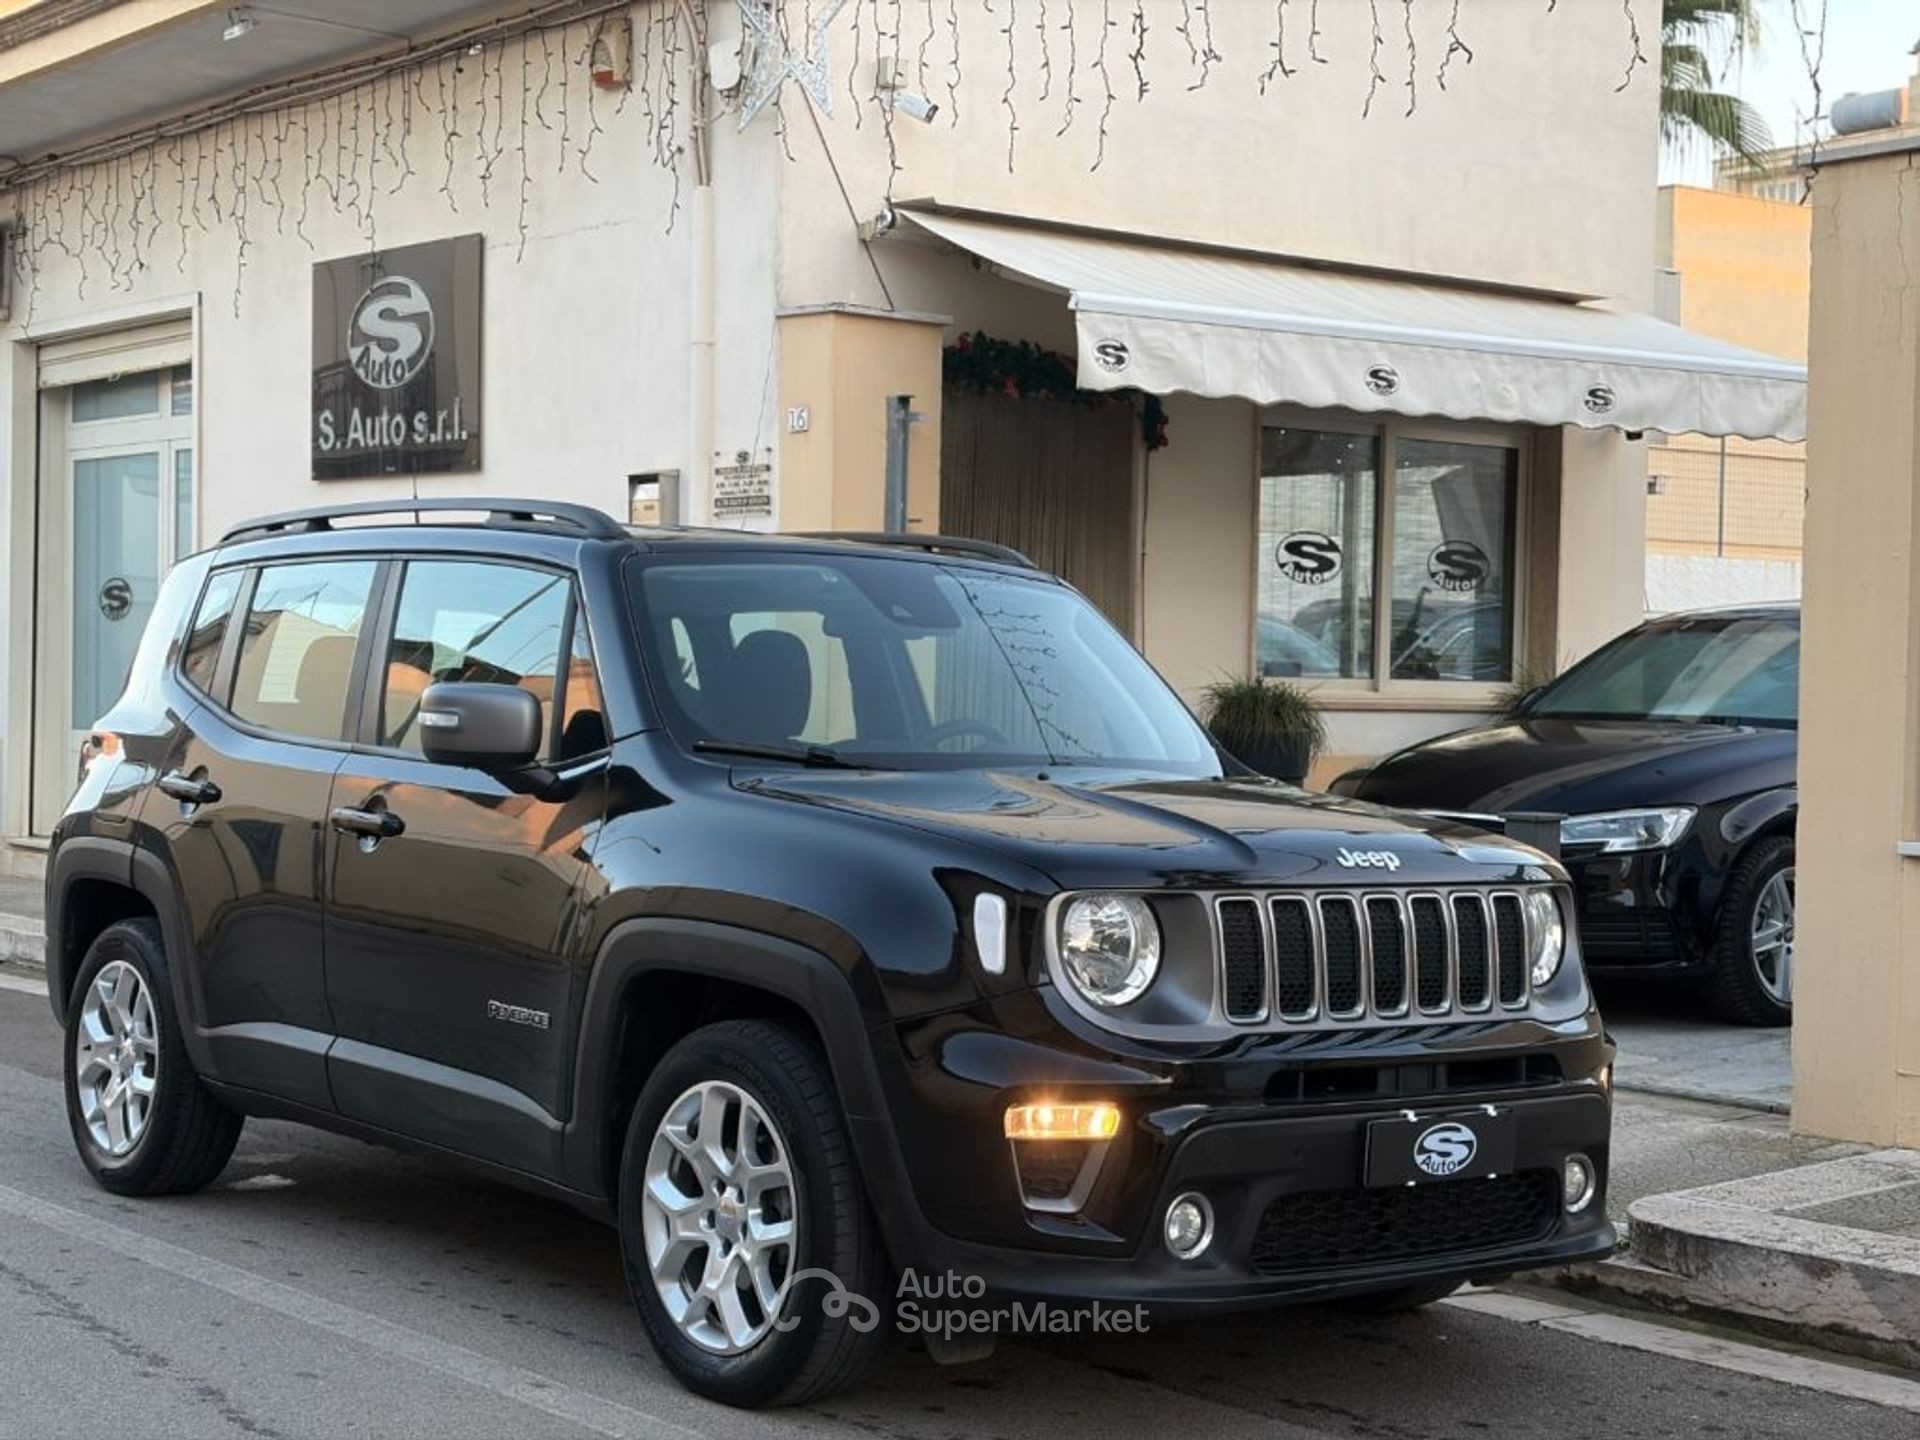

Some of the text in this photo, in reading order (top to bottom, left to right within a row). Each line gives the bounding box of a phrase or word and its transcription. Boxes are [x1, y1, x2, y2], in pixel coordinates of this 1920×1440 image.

[352, 282, 431, 357] S
[355, 345, 408, 386] Auto
[1096, 342, 1128, 366] S
[1367, 368, 1398, 389] S
[1585, 387, 1614, 406] S
[318, 396, 468, 451] S. Auto s.r.l.
[789, 409, 807, 429] 16
[1280, 539, 1340, 572] S
[1431, 549, 1487, 580] S
[1282, 562, 1322, 585] Auto
[1434, 571, 1472, 592] Auto
[1336, 847, 1400, 871] Jeep
[1416, 1127, 1475, 1161] S
[1420, 1154, 1457, 1174] Auto
